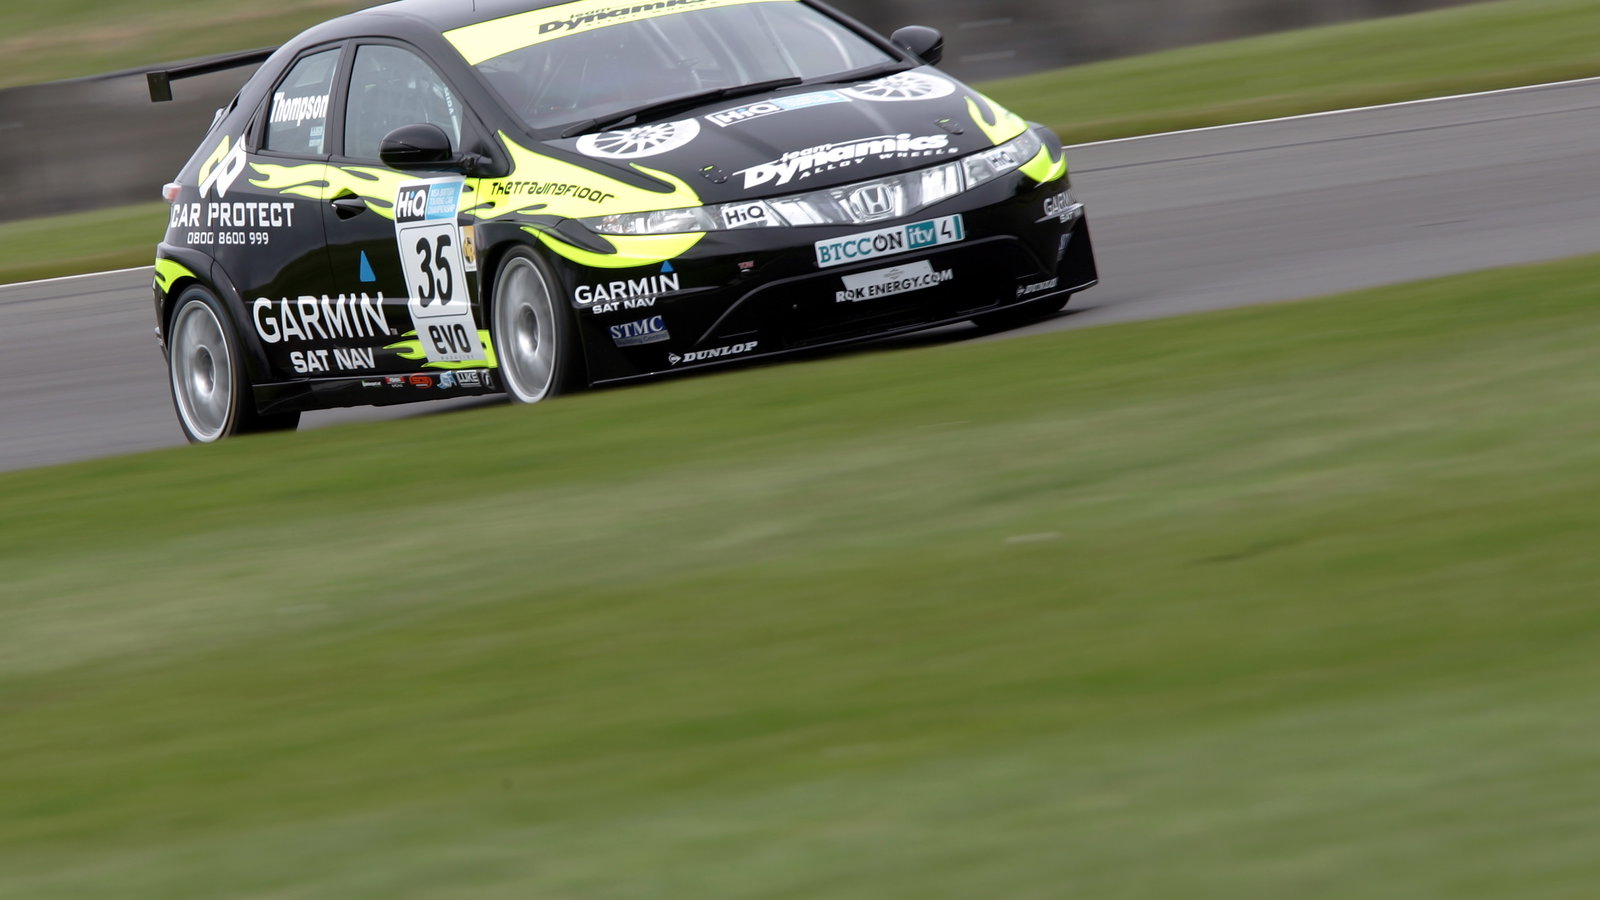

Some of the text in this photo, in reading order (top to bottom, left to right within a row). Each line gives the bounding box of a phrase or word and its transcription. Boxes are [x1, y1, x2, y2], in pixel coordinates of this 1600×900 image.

[270, 88, 329, 127] Thompson
[714, 103, 781, 123] HiQ
[743, 133, 949, 190] Dynamics
[781, 143, 833, 163] team
[799, 147, 959, 180] ALLOY WHEELS
[171, 202, 295, 228] CAR PROTECT
[397, 189, 427, 218] HiQ
[725, 205, 765, 225] HiQ
[187, 232, 269, 244] 0800 8600 999
[416, 234, 453, 308] 35
[574, 272, 680, 304] GARMIN
[836, 286, 866, 303] ROK
[868, 268, 953, 297] ENERGY.COM
[253, 291, 391, 344] GARMIN
[592, 297, 656, 315] SAT NAV
[428, 323, 471, 355] evo
[610, 314, 664, 339] STMC
[290, 347, 376, 374] SAT NAV
[682, 341, 758, 362] DUNLOP
